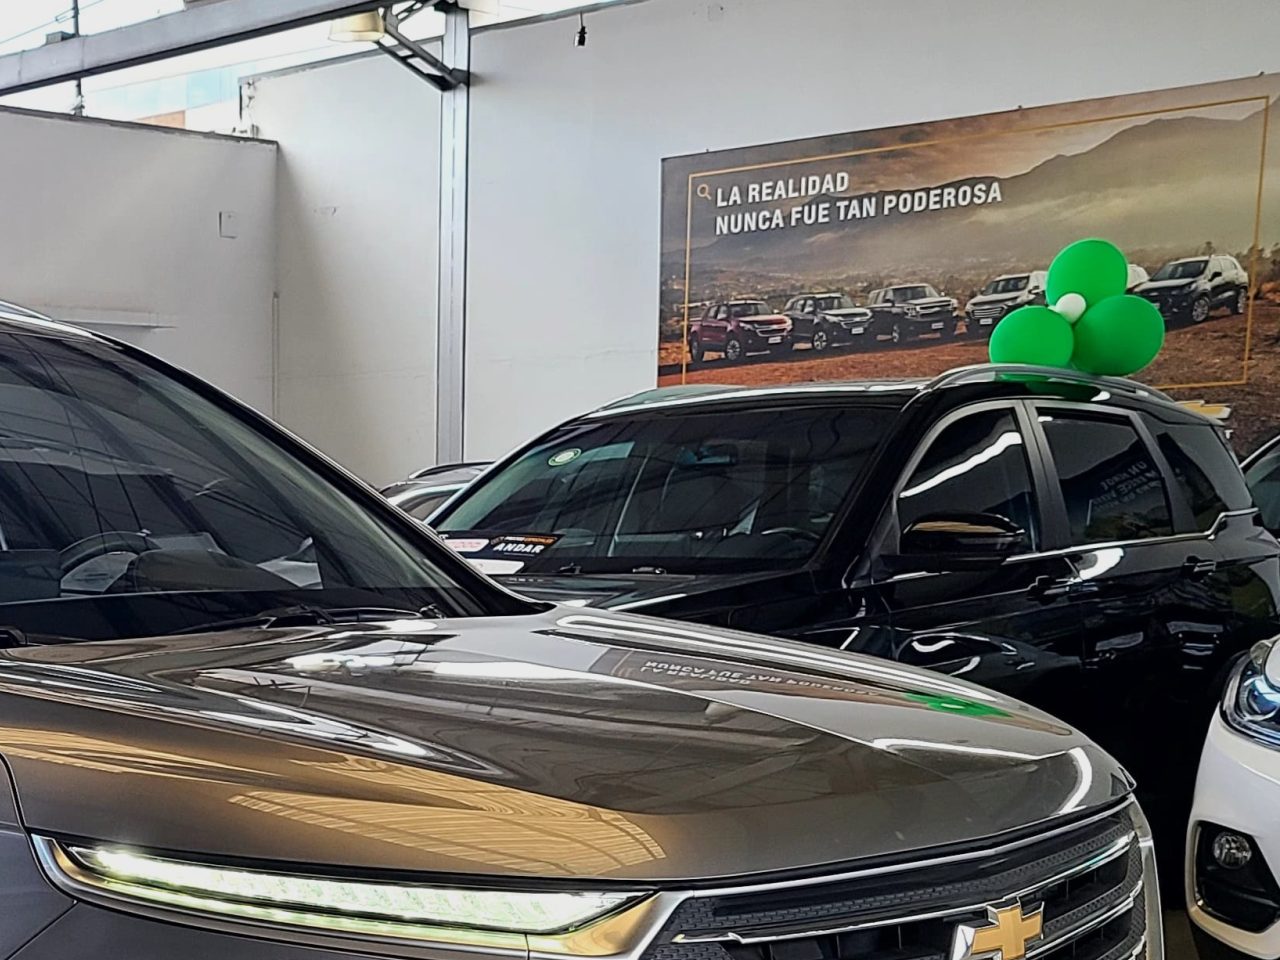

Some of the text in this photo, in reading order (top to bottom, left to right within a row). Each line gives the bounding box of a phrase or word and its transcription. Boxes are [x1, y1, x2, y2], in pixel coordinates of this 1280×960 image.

[716, 172, 849, 207] LA REALIDAD
[715, 181, 1003, 236] NUNCA FUE TAN PODEROSA
[492, 542, 545, 554] ANDAR
